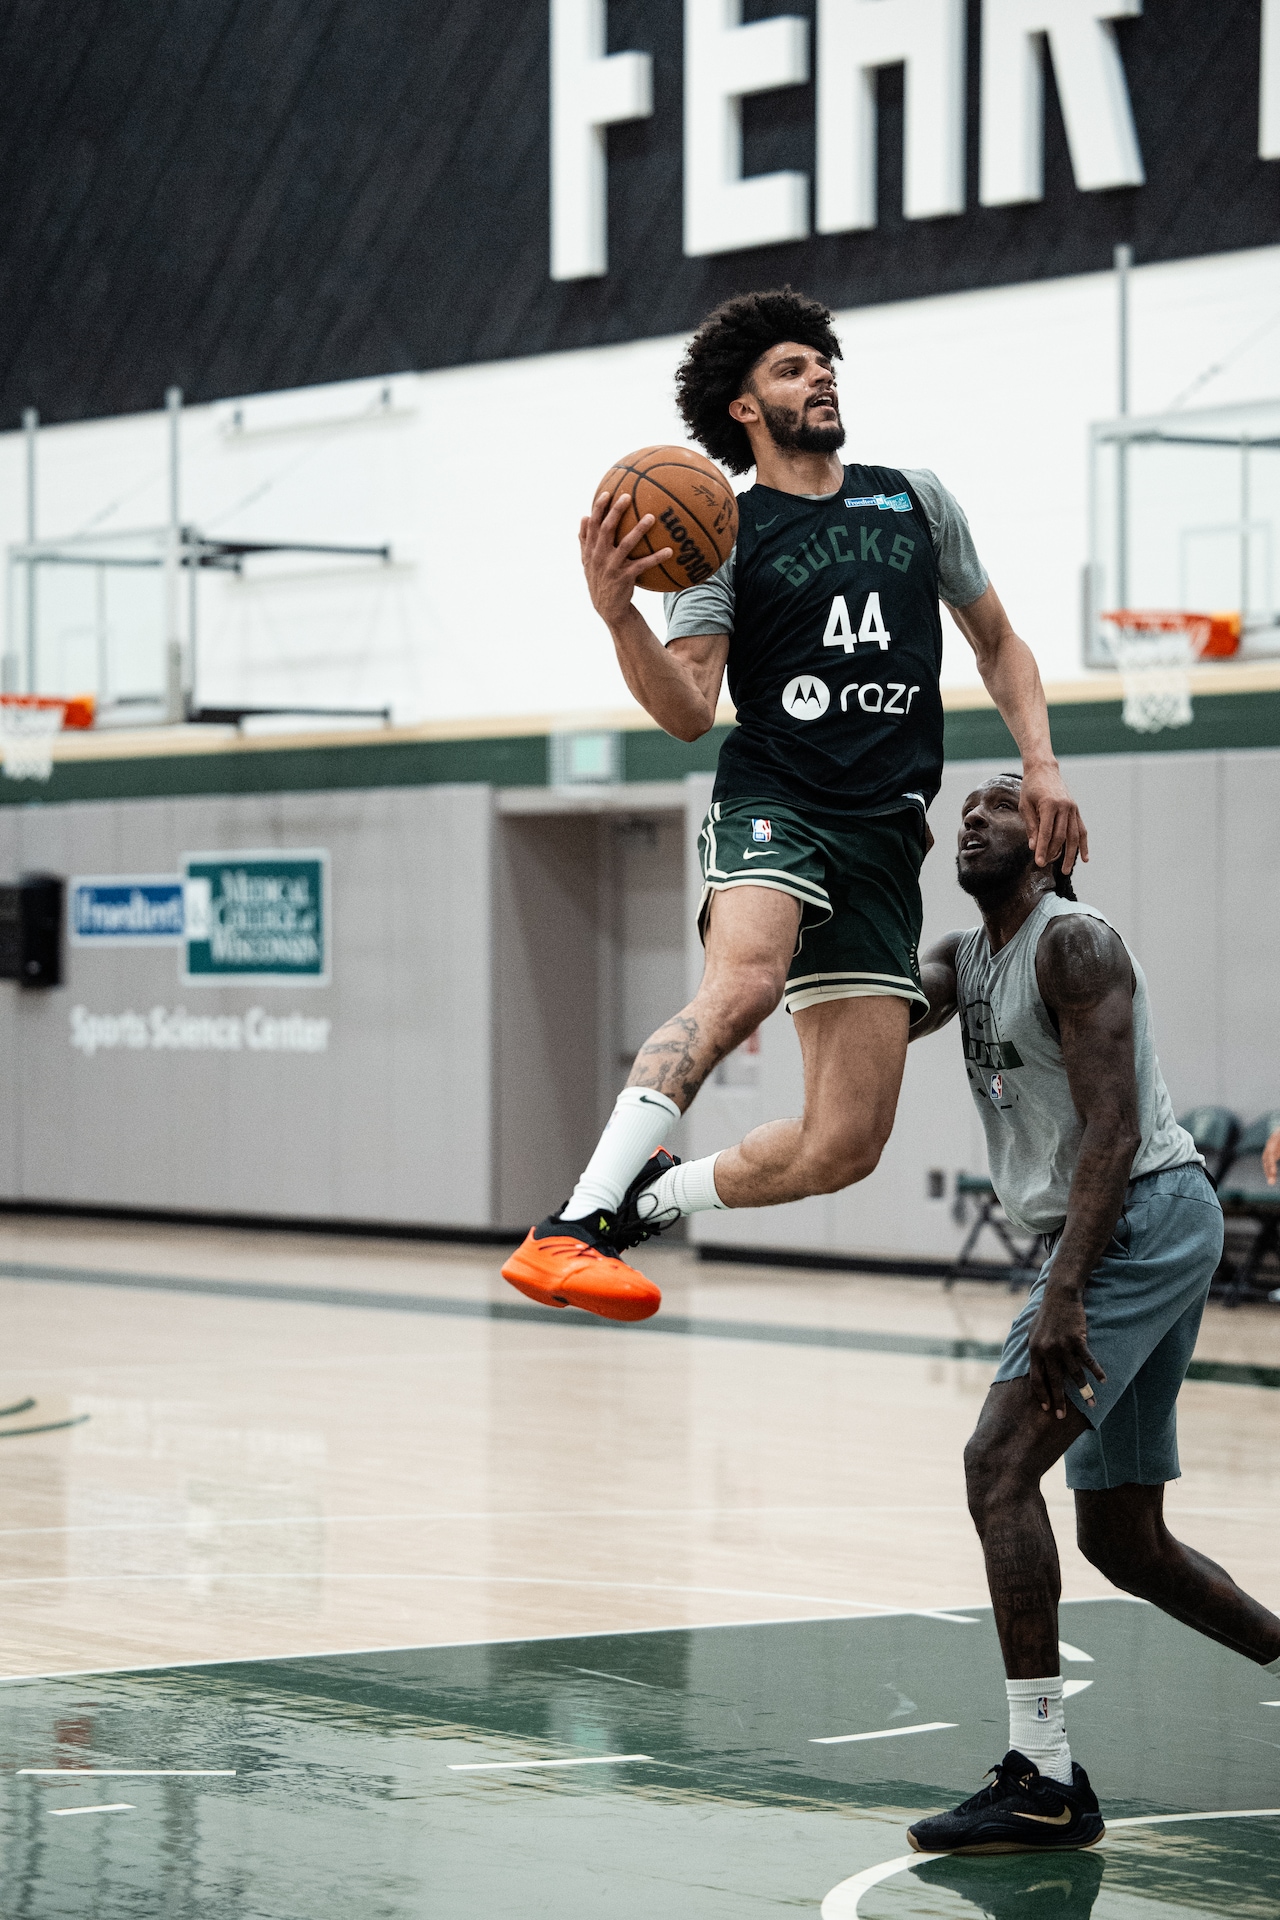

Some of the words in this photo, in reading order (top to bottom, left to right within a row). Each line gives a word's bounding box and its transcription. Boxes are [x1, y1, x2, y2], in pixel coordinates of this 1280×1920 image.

[771, 525, 916, 588] BUCKS
[822, 591, 892, 654] 44
[840, 682, 920, 715] razr
[70, 1003, 148, 1057] Sports
[149, 1003, 242, 1051] Science
[245, 1005, 331, 1053] Center
